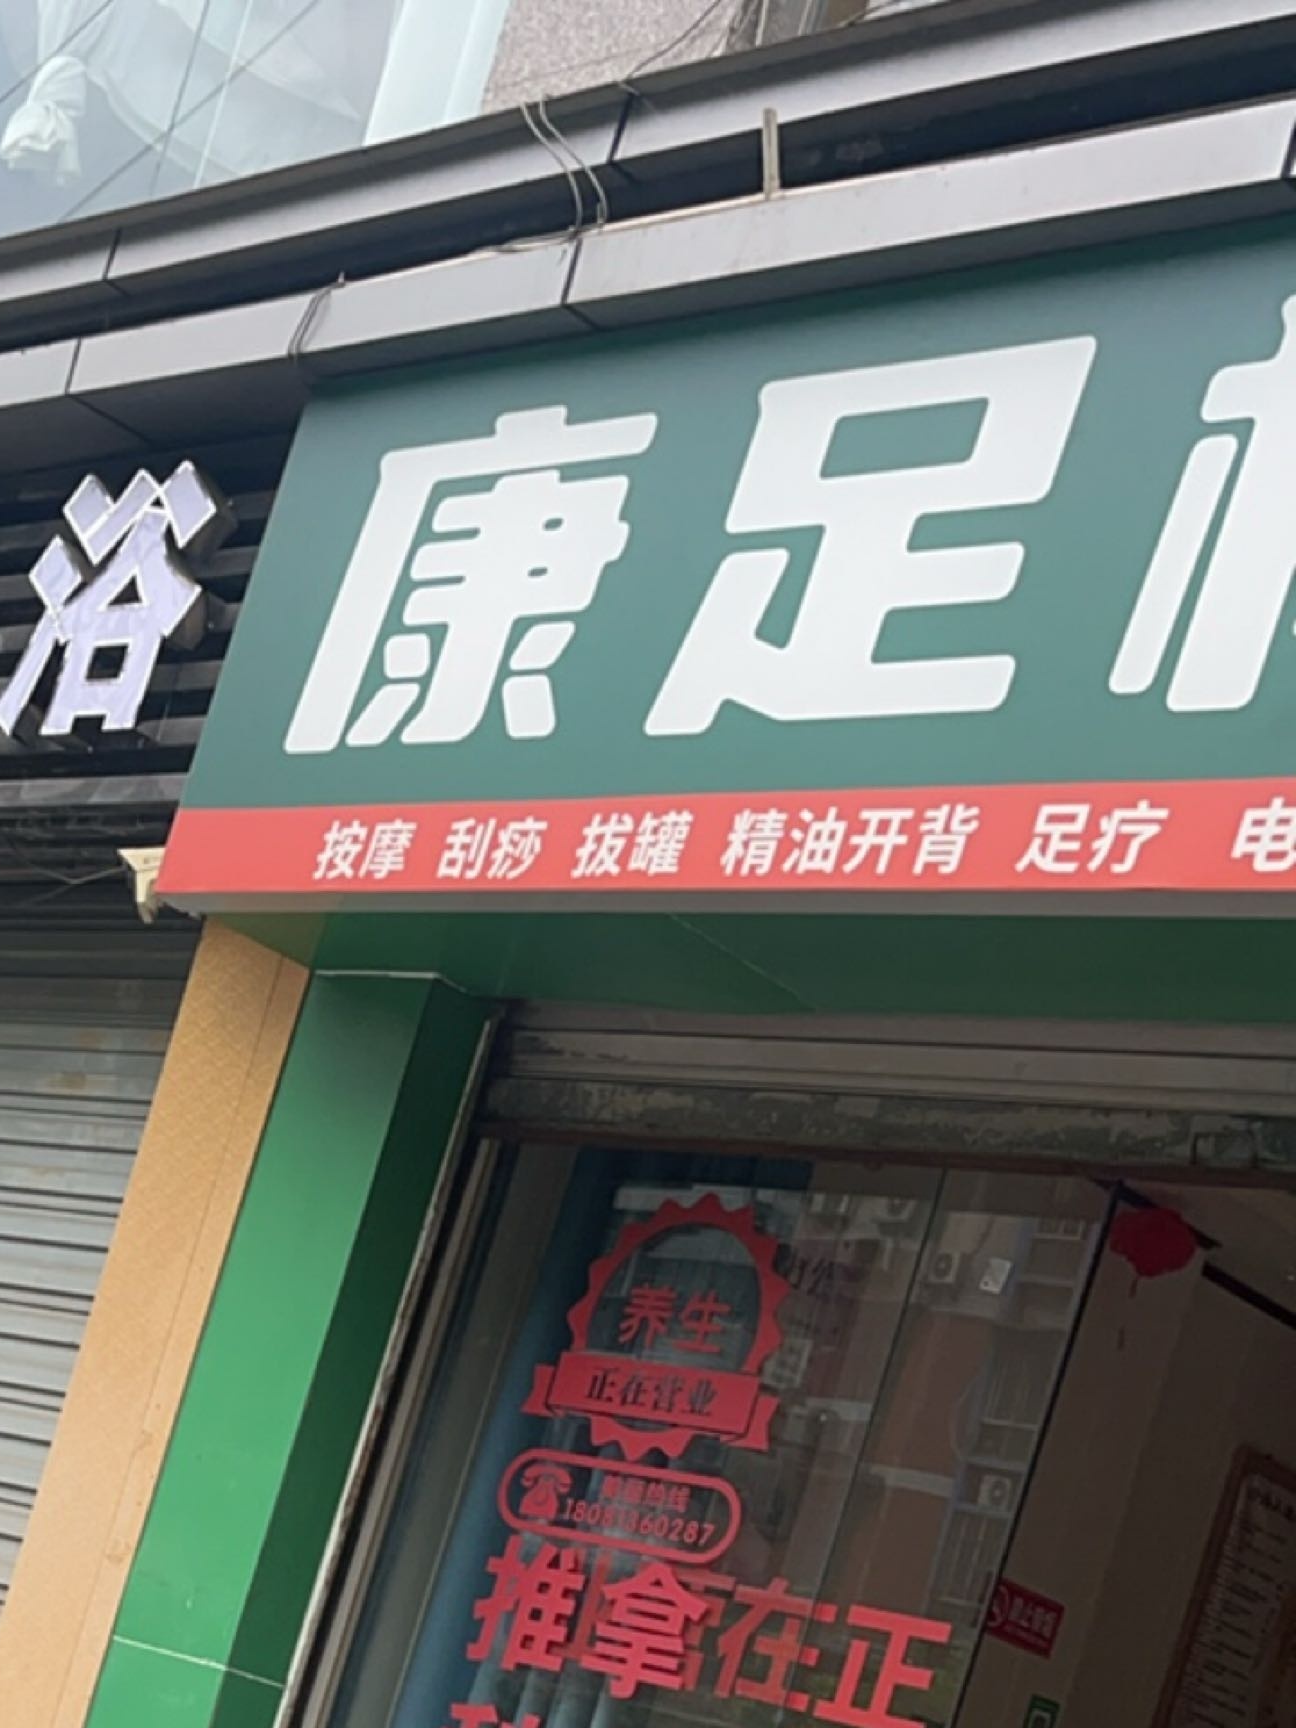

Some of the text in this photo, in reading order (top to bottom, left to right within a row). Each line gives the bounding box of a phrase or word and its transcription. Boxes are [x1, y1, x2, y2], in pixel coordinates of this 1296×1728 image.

[312, 818, 417, 880] 按摩
[436, 816, 549, 881] 刮痧
[570, 809, 694, 880] 拔罐
[720, 803, 981, 878] 精油开背
[1015, 799, 1170, 875] 足疗
[617, 1283, 732, 1356] 养生
[584, 1366, 718, 1419] 正在营业
[465, 1536, 712, 1698] 推拿
